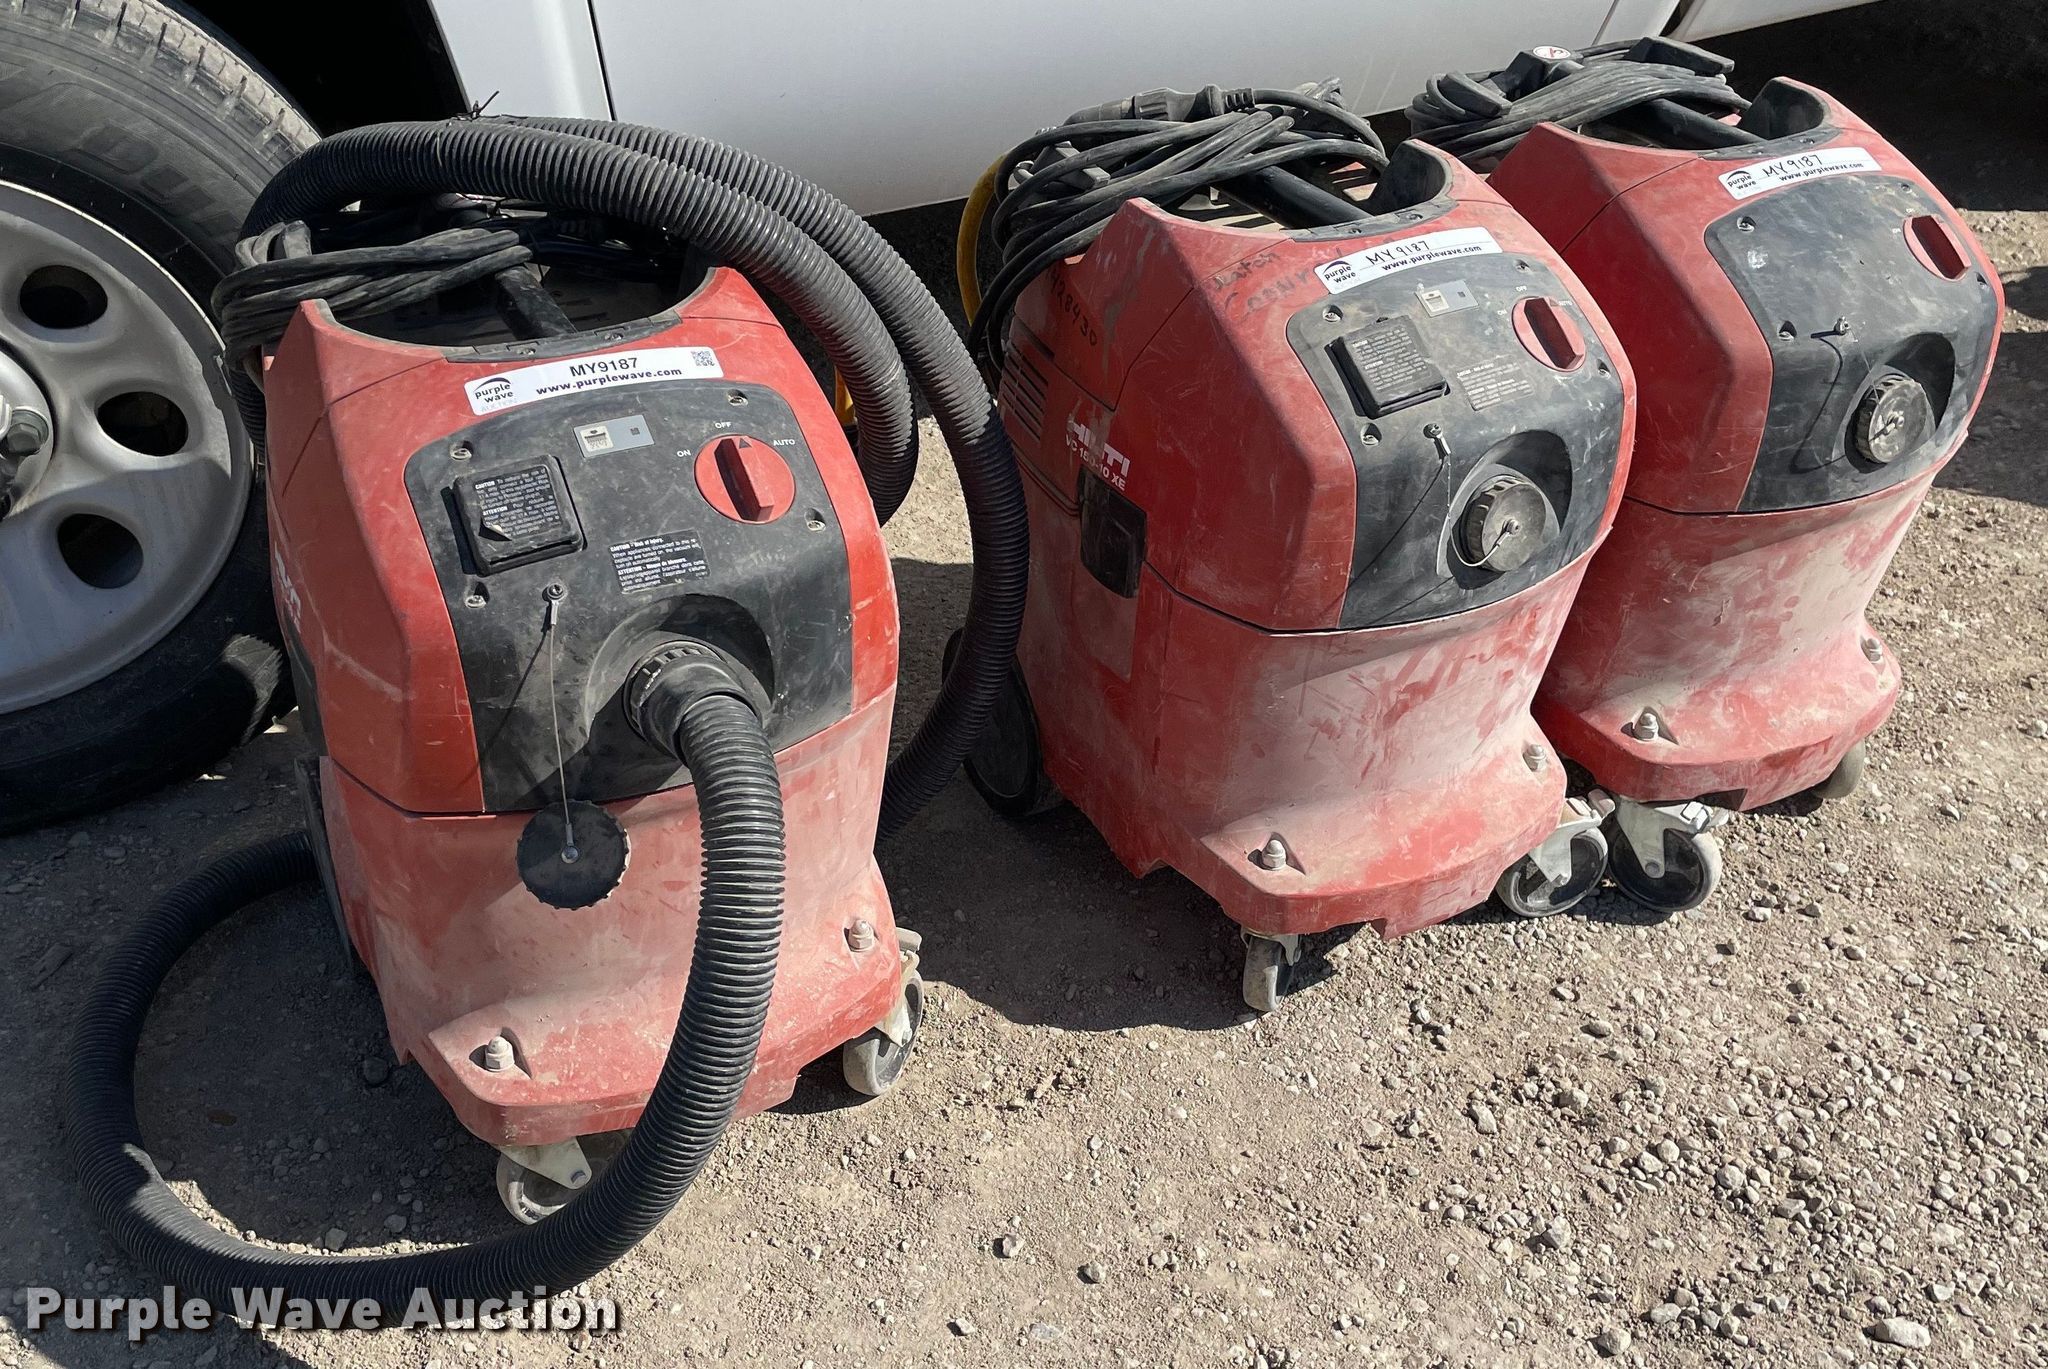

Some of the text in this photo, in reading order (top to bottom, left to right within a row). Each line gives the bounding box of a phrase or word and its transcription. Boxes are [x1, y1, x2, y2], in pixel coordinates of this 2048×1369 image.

[1779, 162, 1864, 182] www.purplewave.com
[1727, 174, 1752, 187] purple
[1736, 180, 1757, 190] wave
[1381, 245, 1482, 271] www.purplewave.com
[1325, 266, 1352, 280] purple
[1333, 271, 1356, 284] wave
[569, 357, 638, 378] MY9187
[536, 368, 682, 396] www.purplewave.com
[474, 383, 511, 400] purple
[484, 390, 514, 404] wave
[714, 421, 732, 429] OFF
[773, 439, 795, 447] AUTO
[676, 449, 692, 457] ON
[1065, 433, 1078, 452] VC
[1111, 472, 1127, 492] XE
